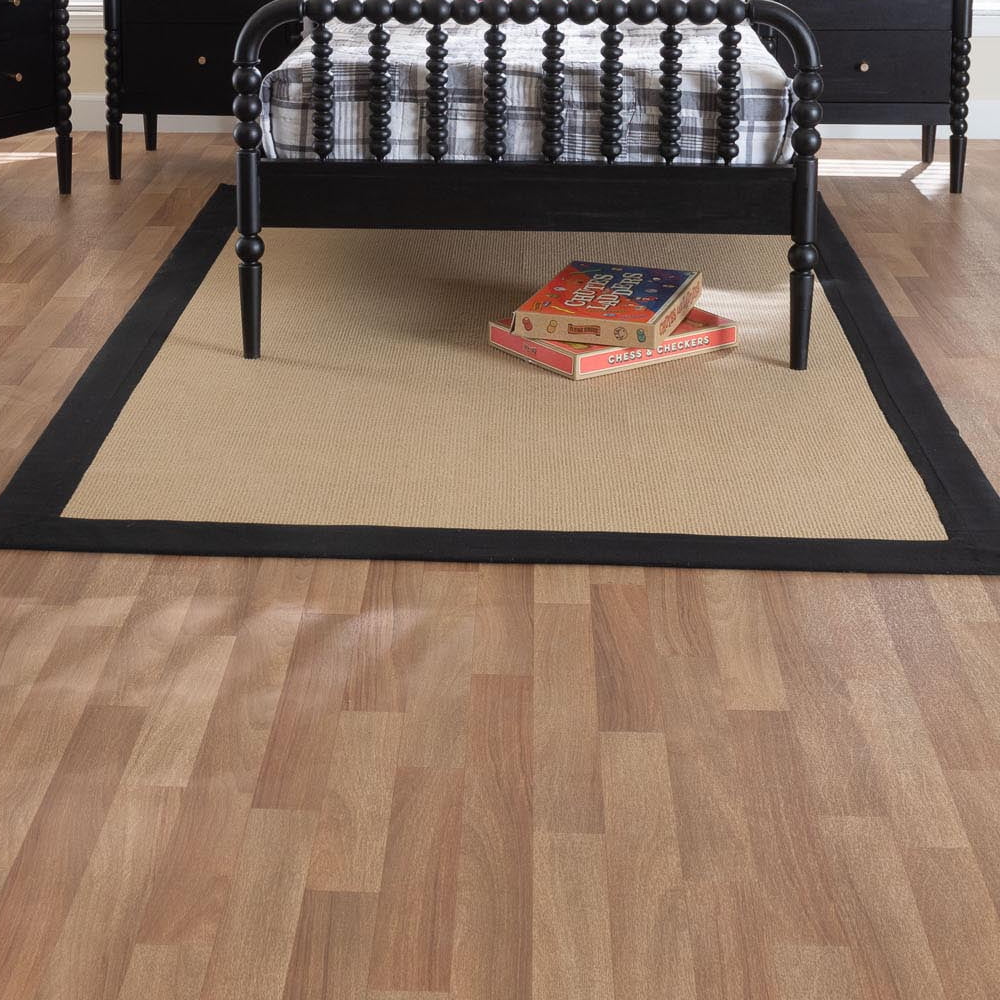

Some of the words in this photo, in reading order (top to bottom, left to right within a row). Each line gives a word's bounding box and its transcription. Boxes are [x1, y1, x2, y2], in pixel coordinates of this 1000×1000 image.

[564, 273, 614, 308] CHUTES
[586, 272, 644, 311] LADDERS
[608, 349, 643, 365] CHESS
[646, 348, 653, 356] &
[657, 335, 711, 355] CHECKERS
